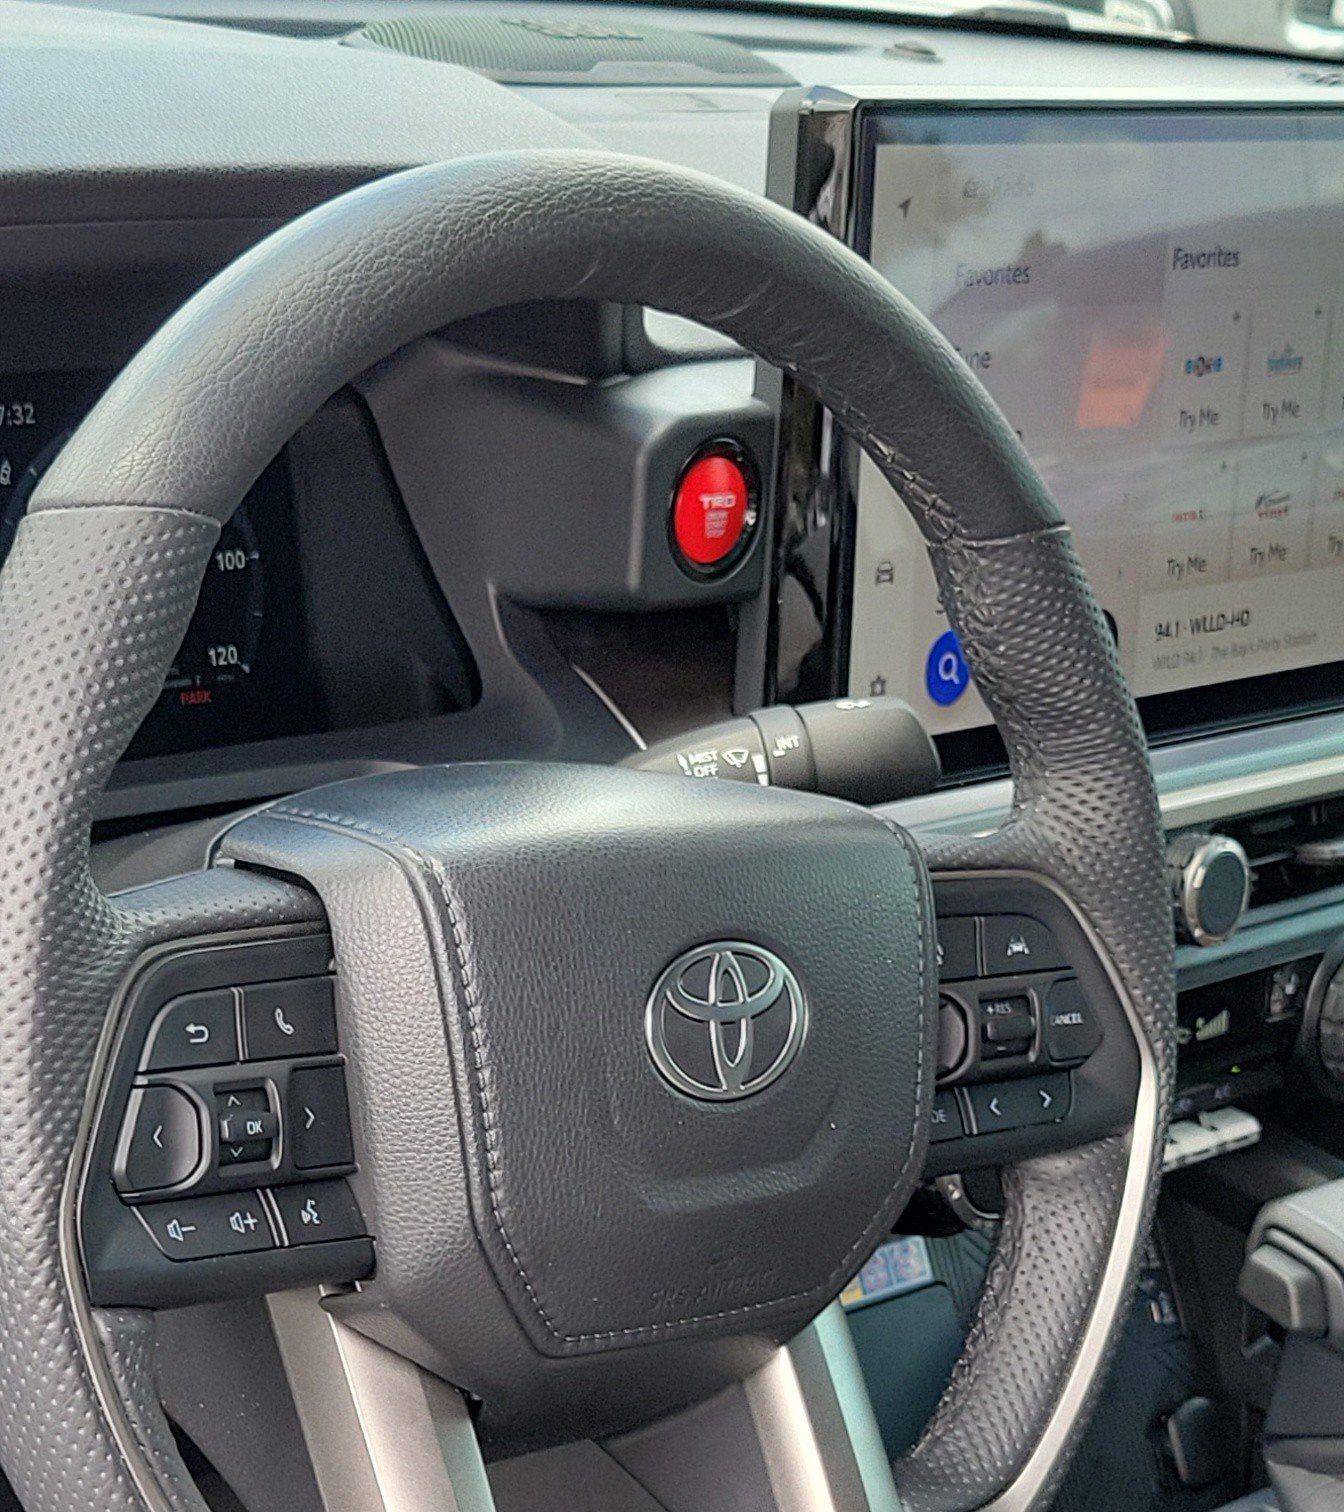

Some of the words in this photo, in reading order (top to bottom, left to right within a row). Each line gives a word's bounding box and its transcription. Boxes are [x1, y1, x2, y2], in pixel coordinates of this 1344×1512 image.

[1172, 248, 1240, 271] Favorites
[957, 265, 1031, 287] Favorites
[1199, 408, 1221, 426] Me
[1281, 400, 1302, 418] Me
[216, 549, 246, 571] 100
[1268, 544, 1287, 561] Me
[1186, 556, 1207, 573] Me
[208, 644, 238, 667] 120
[179, 690, 213, 705] PARK
[775, 735, 800, 751] INT
[688, 749, 718, 766] MIST
[693, 763, 719, 778] OFF
[1050, 1011, 1085, 1027] CANCEL
[245, 1119, 264, 1135] OK
